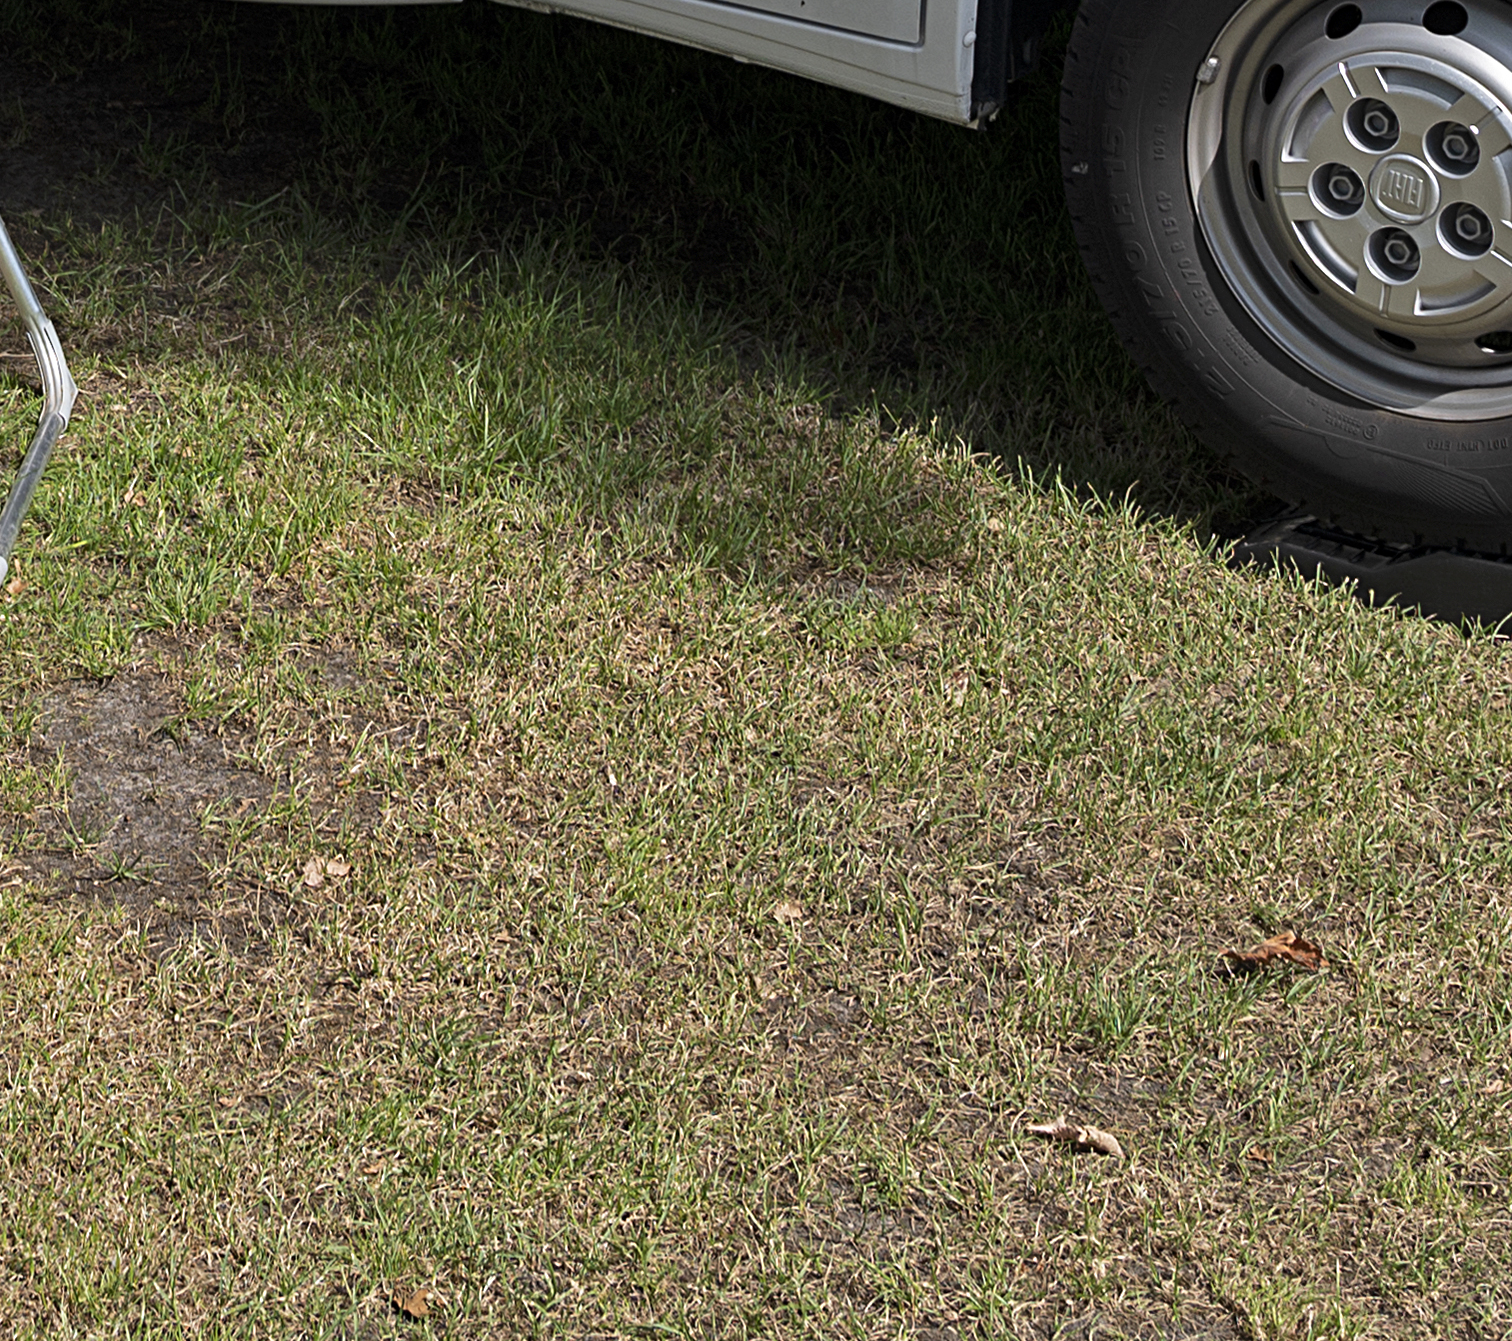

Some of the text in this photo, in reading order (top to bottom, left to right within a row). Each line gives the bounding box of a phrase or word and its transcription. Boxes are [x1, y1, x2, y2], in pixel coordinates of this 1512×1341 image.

[1103, 46, 1134, 112] CP
[1101, 122, 1127, 177] 15
[1110, 191, 1136, 226] R
[1154, 189, 1219, 317] 215/70 R 15 CP
